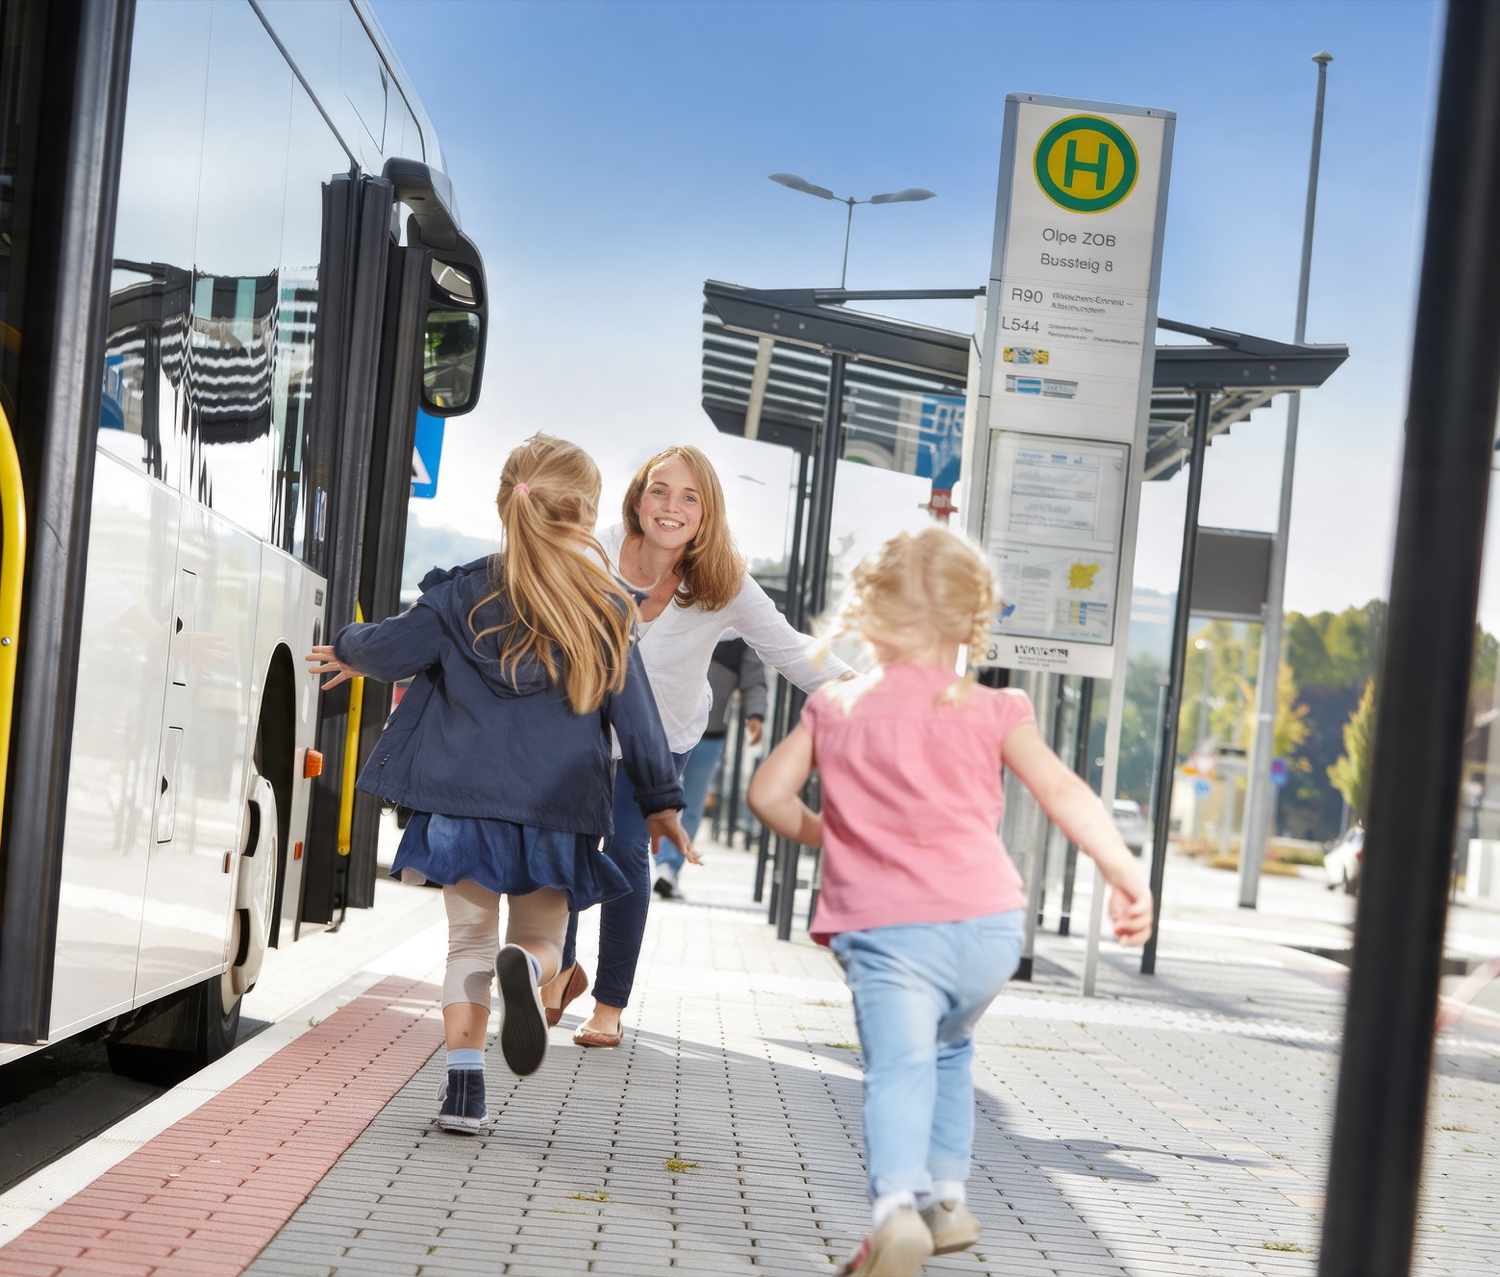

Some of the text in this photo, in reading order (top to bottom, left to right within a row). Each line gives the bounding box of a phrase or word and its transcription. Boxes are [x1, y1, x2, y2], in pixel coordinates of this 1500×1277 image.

[1063, 139, 1109, 190] H
[1042, 228, 1116, 247] Olpe ZOB
[1040, 253, 1113, 273] Bussteig 8
[1011, 287, 1043, 304] R90
[1002, 316, 1039, 333] L544
